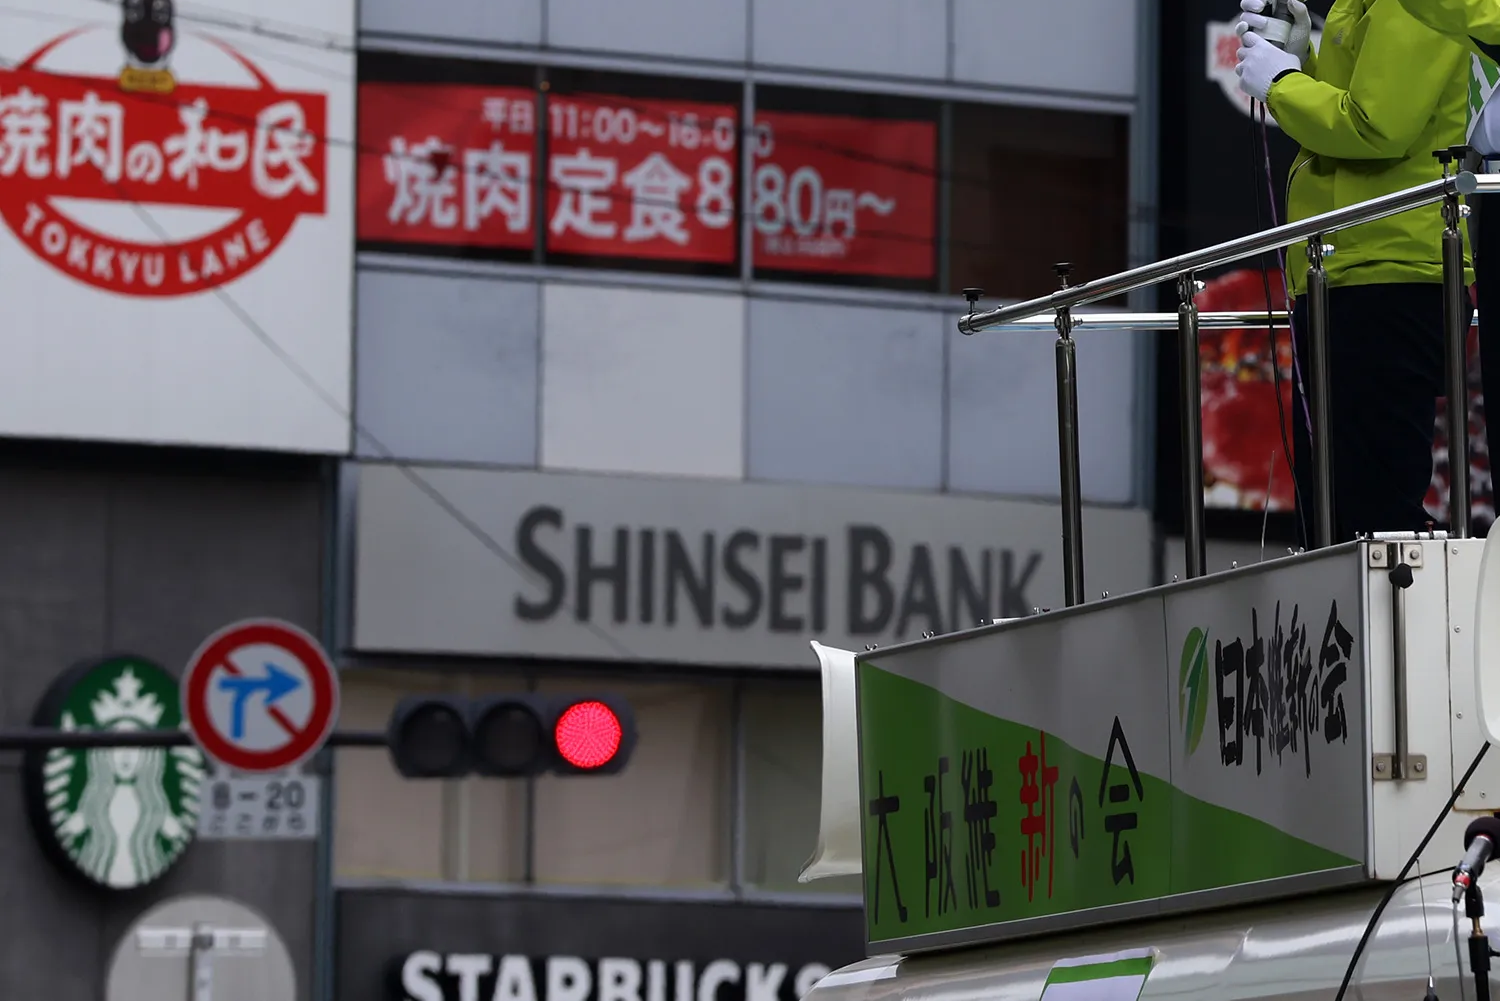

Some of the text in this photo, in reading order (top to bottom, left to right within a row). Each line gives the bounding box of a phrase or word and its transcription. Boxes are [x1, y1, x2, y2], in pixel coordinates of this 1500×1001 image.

[0, 87, 319, 199] 焼肉の和民
[22, 202, 271, 287] TOKKYU LANE
[513, 505, 1045, 638] SHINSEI BANK
[1215, 599, 1355, 780] 日本維新の会
[869, 715, 1144, 926] 大阪維新の会
